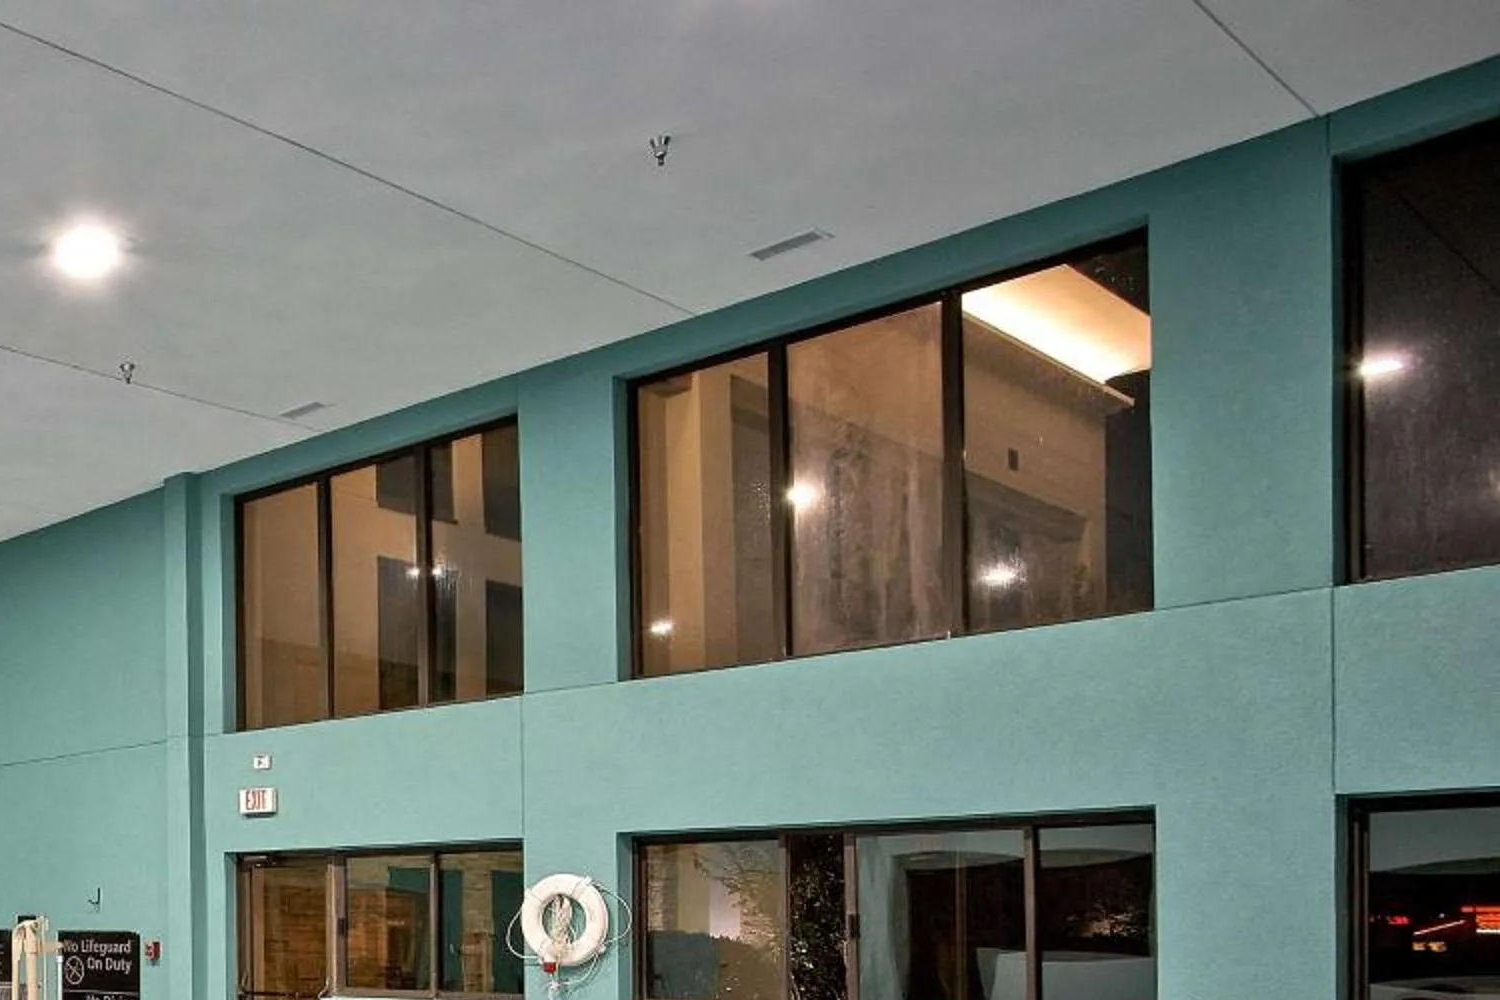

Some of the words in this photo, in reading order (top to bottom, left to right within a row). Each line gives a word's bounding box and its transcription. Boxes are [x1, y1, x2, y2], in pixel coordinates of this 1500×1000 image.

[246, 790, 265, 810] EXIT
[63, 939, 79, 952] No
[81, 938, 132, 957] Lifeguard
[87, 956, 103, 970] On
[105, 957, 133, 975] Duty
